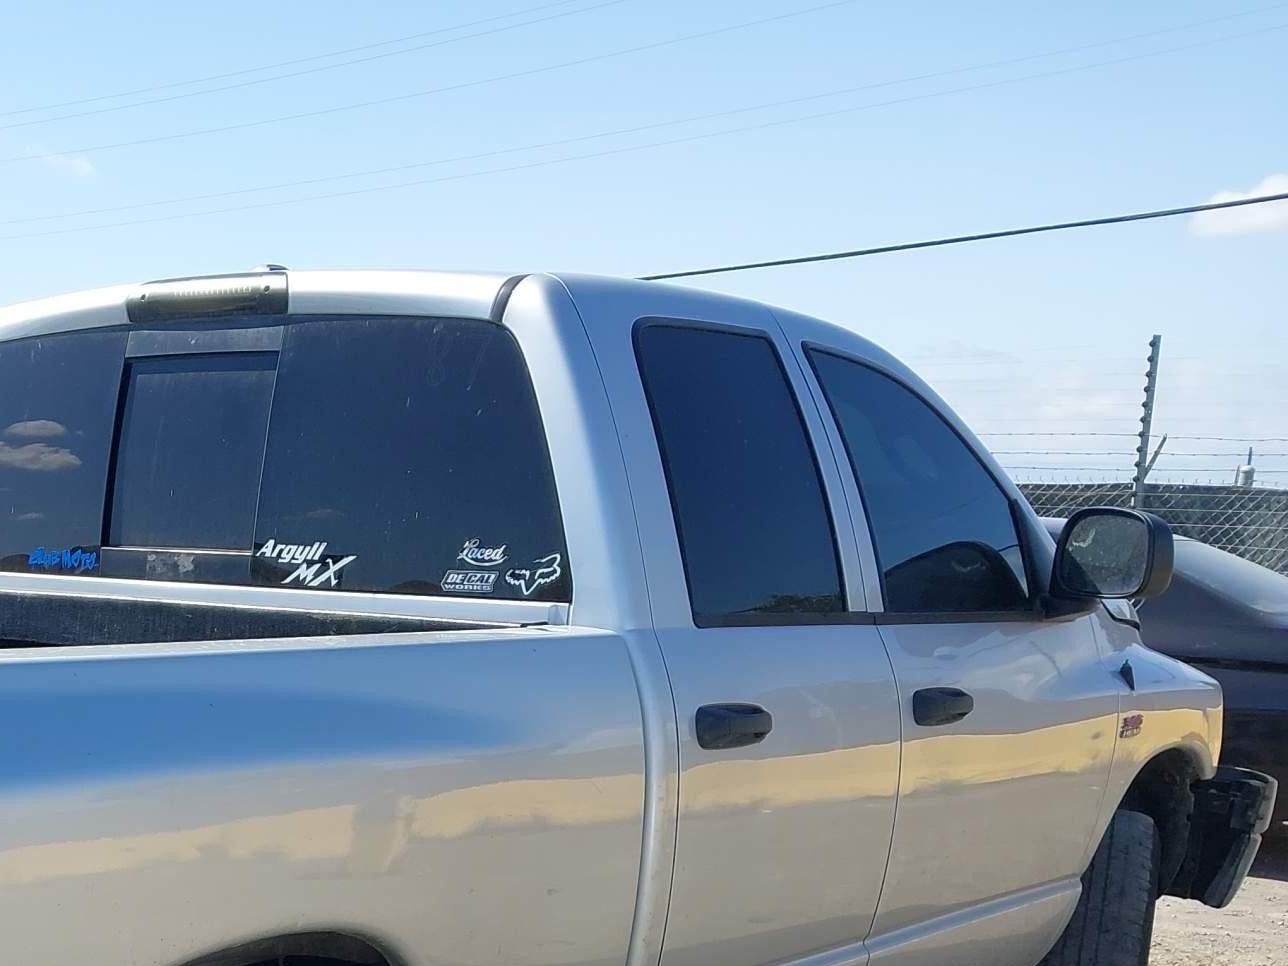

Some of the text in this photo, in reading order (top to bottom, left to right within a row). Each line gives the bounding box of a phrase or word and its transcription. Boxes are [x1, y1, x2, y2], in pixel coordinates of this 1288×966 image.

[255, 539, 328, 564] Argyll
[456, 538, 507, 563] Laced
[280, 555, 357, 587] MX
